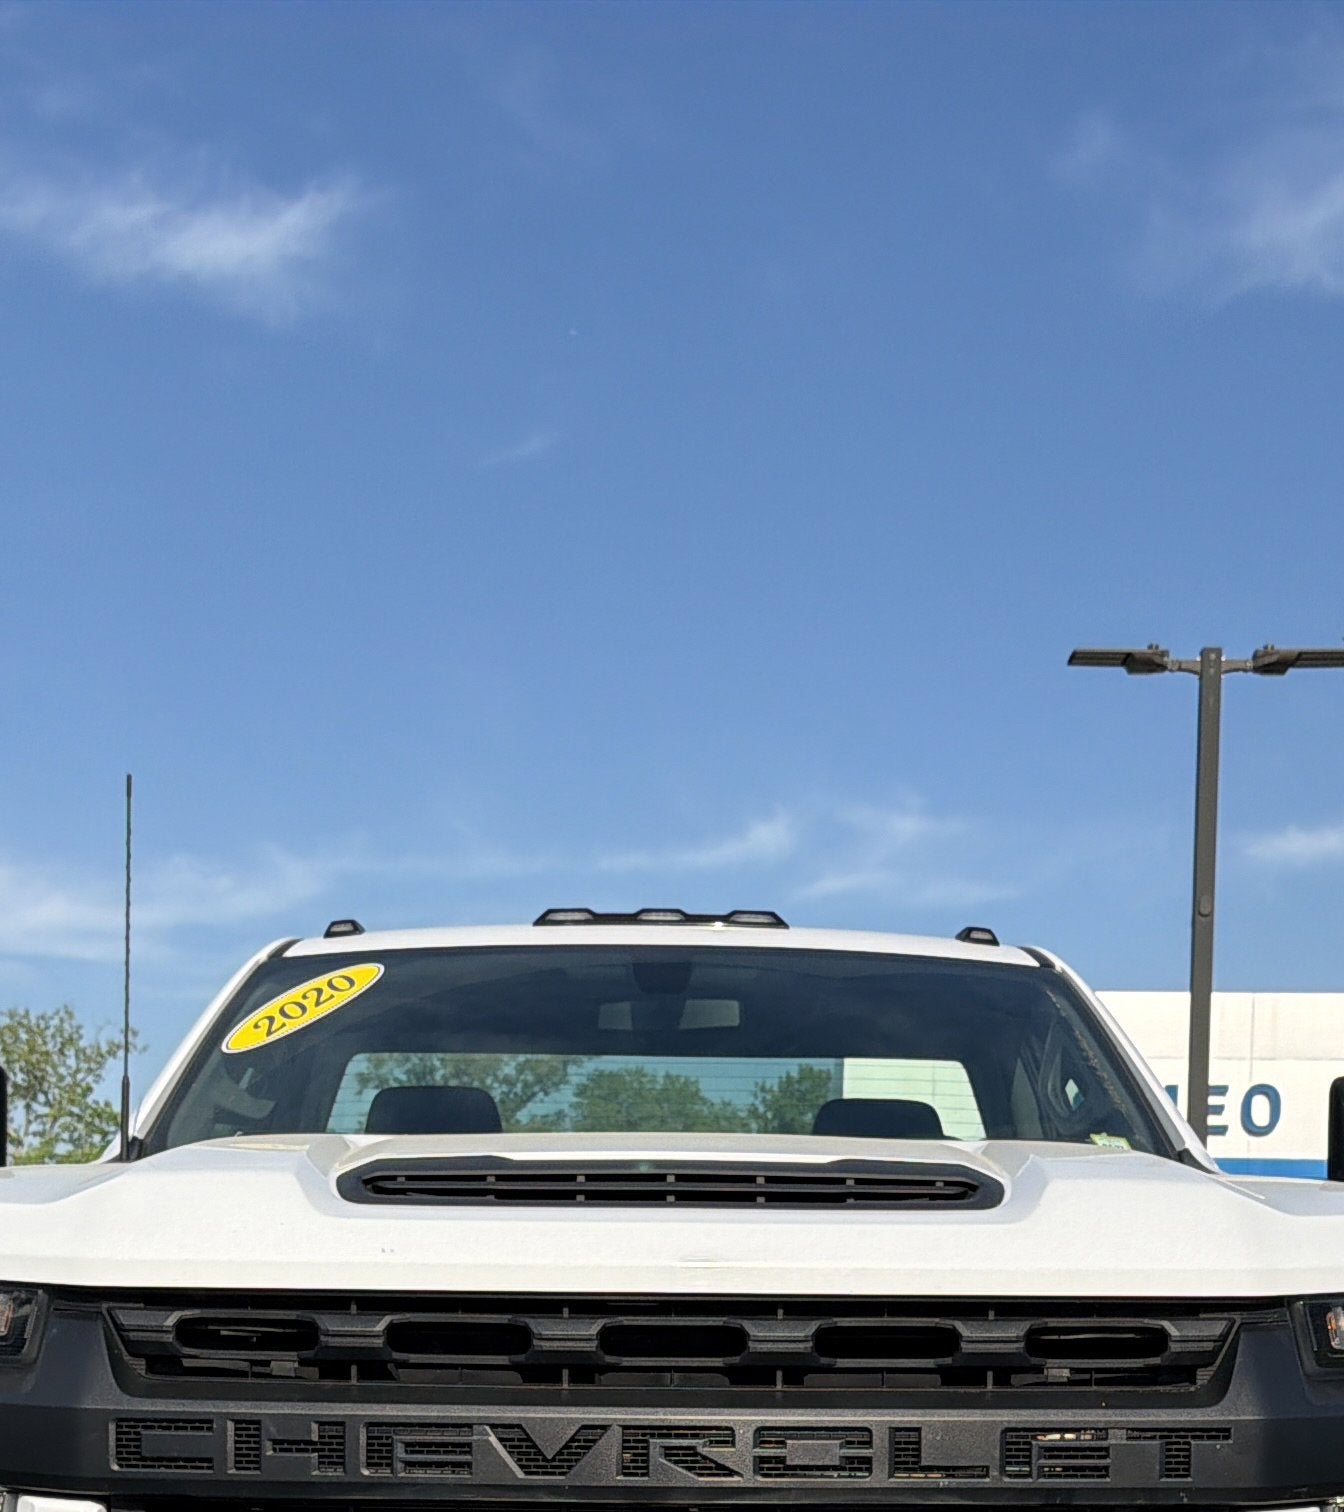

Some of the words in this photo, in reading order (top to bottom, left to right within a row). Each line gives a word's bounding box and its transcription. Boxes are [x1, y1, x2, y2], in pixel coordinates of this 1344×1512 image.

[253, 973, 357, 1036] 2020
[1165, 1083, 1282, 1137] EO
[109, 1417, 1233, 1482] CHEVROLET
